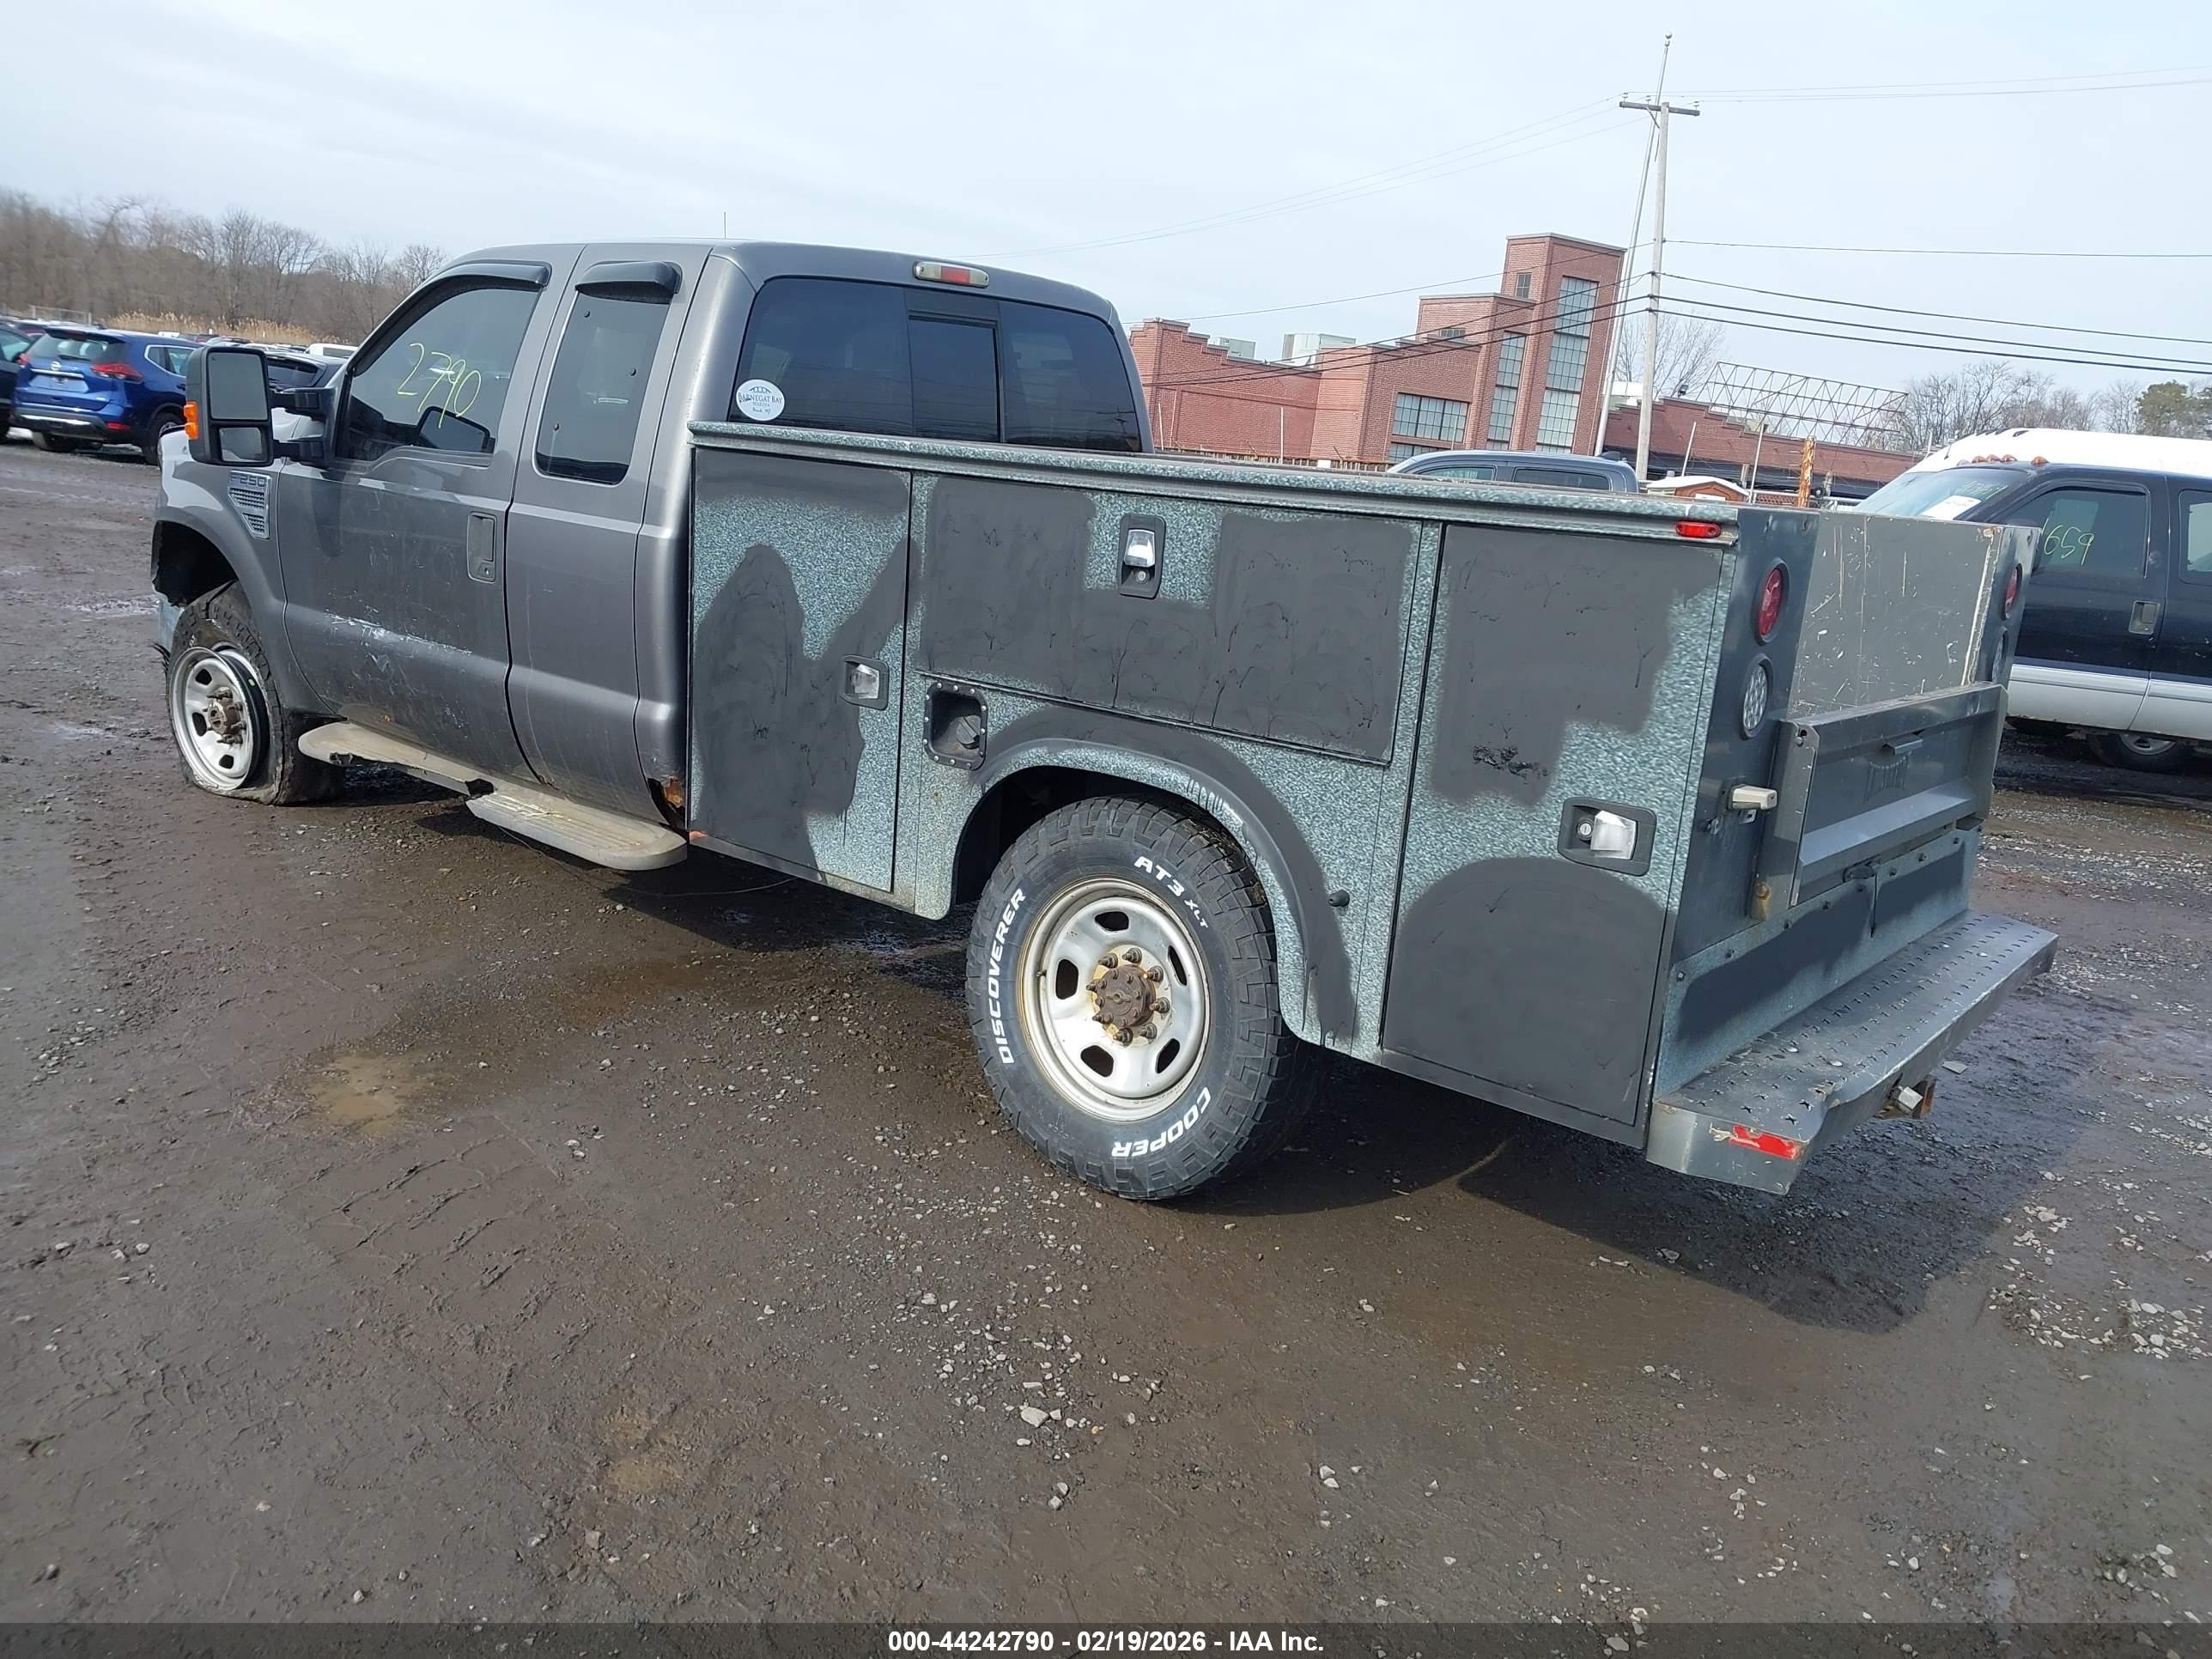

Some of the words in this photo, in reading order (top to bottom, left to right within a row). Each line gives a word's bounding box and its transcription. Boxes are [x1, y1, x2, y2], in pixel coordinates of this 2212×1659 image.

[397, 343, 482, 429] 2790
[1133, 855, 1185, 897] AT3
[1183, 898, 1209, 928] XLT
[990, 887, 1028, 1066] DISCOVERER
[1111, 1085, 1212, 1158] COOPER
